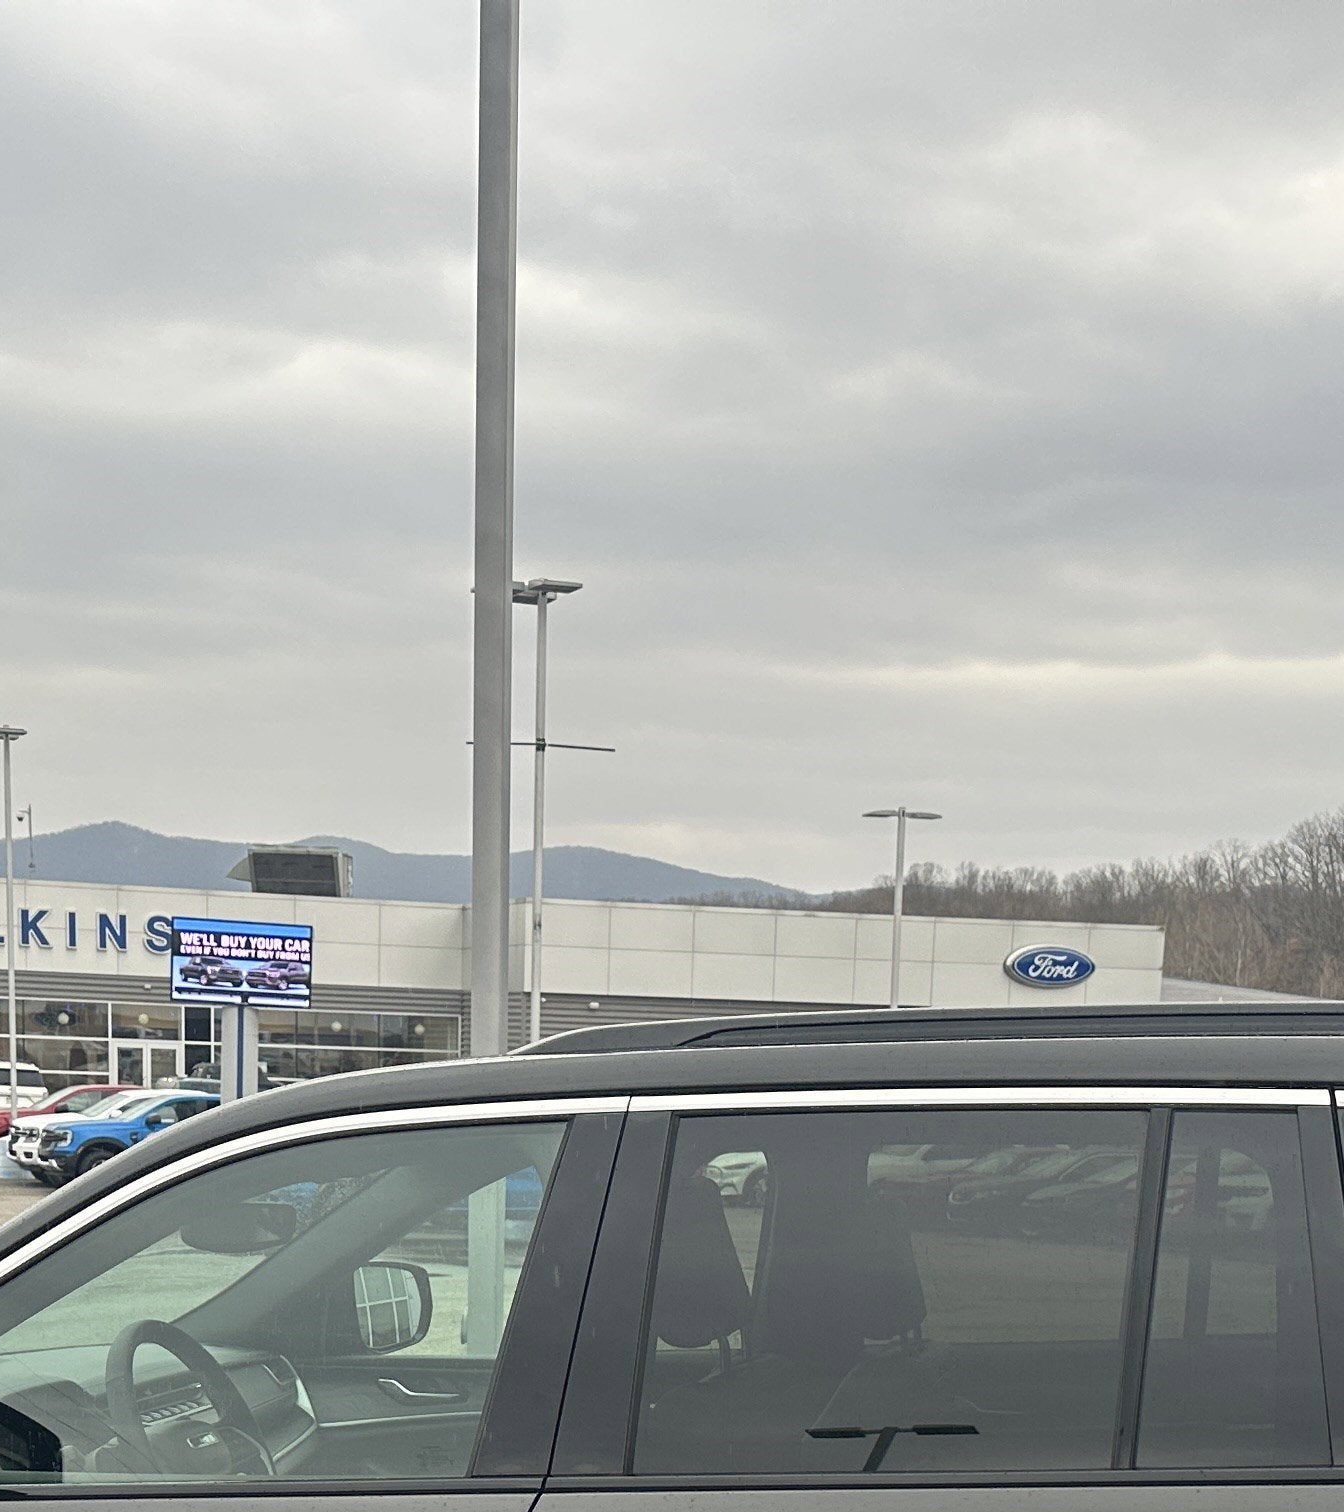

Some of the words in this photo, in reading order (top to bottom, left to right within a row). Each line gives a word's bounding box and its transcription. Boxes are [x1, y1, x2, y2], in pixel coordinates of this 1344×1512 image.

[180, 932, 217, 946] WE'LL
[221, 935, 247, 948] BUY
[249, 936, 283, 950] YOUR
[284, 939, 310, 952] CAR
[1028, 953, 1079, 978] Ford
